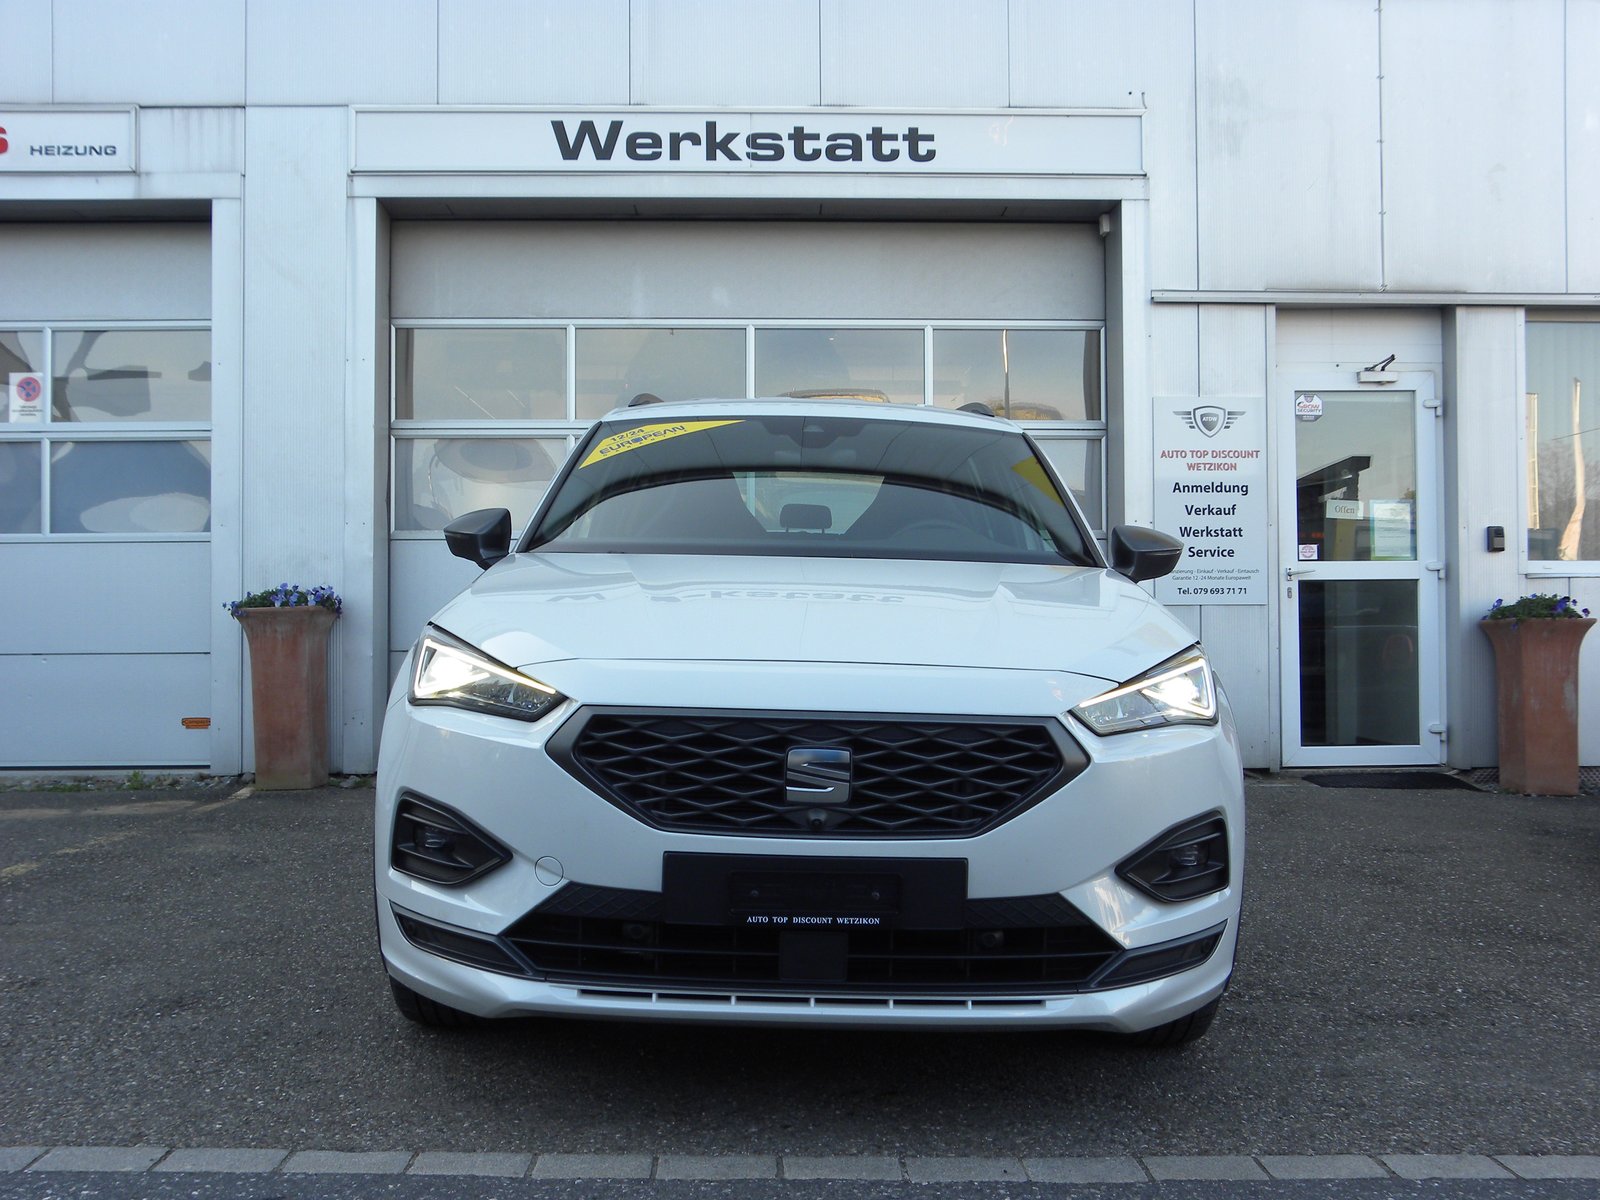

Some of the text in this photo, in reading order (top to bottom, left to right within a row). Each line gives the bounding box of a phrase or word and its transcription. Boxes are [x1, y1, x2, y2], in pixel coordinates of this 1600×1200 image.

[551, 120, 937, 162] Werkstatt
[30, 145, 117, 156] HEIZUNG
[611, 428, 645, 442] 12/24
[1160, 450, 1260, 458] AUTO TOP DISCOUNT
[1186, 462, 1237, 471] WETZIKON
[1172, 481, 1249, 496] Anmeldung
[1184, 504, 1237, 516] Verkauf
[1334, 504, 1355, 514] Offen
[1179, 526, 1244, 538] Werkstatt
[1188, 546, 1235, 558] Service
[1177, 587, 1247, 595] Tel. 079 693 71 71
[746, 916, 769, 924] AUTO
[772, 916, 789, 924] TOP
[836, 917, 880, 925] WETZIKON
